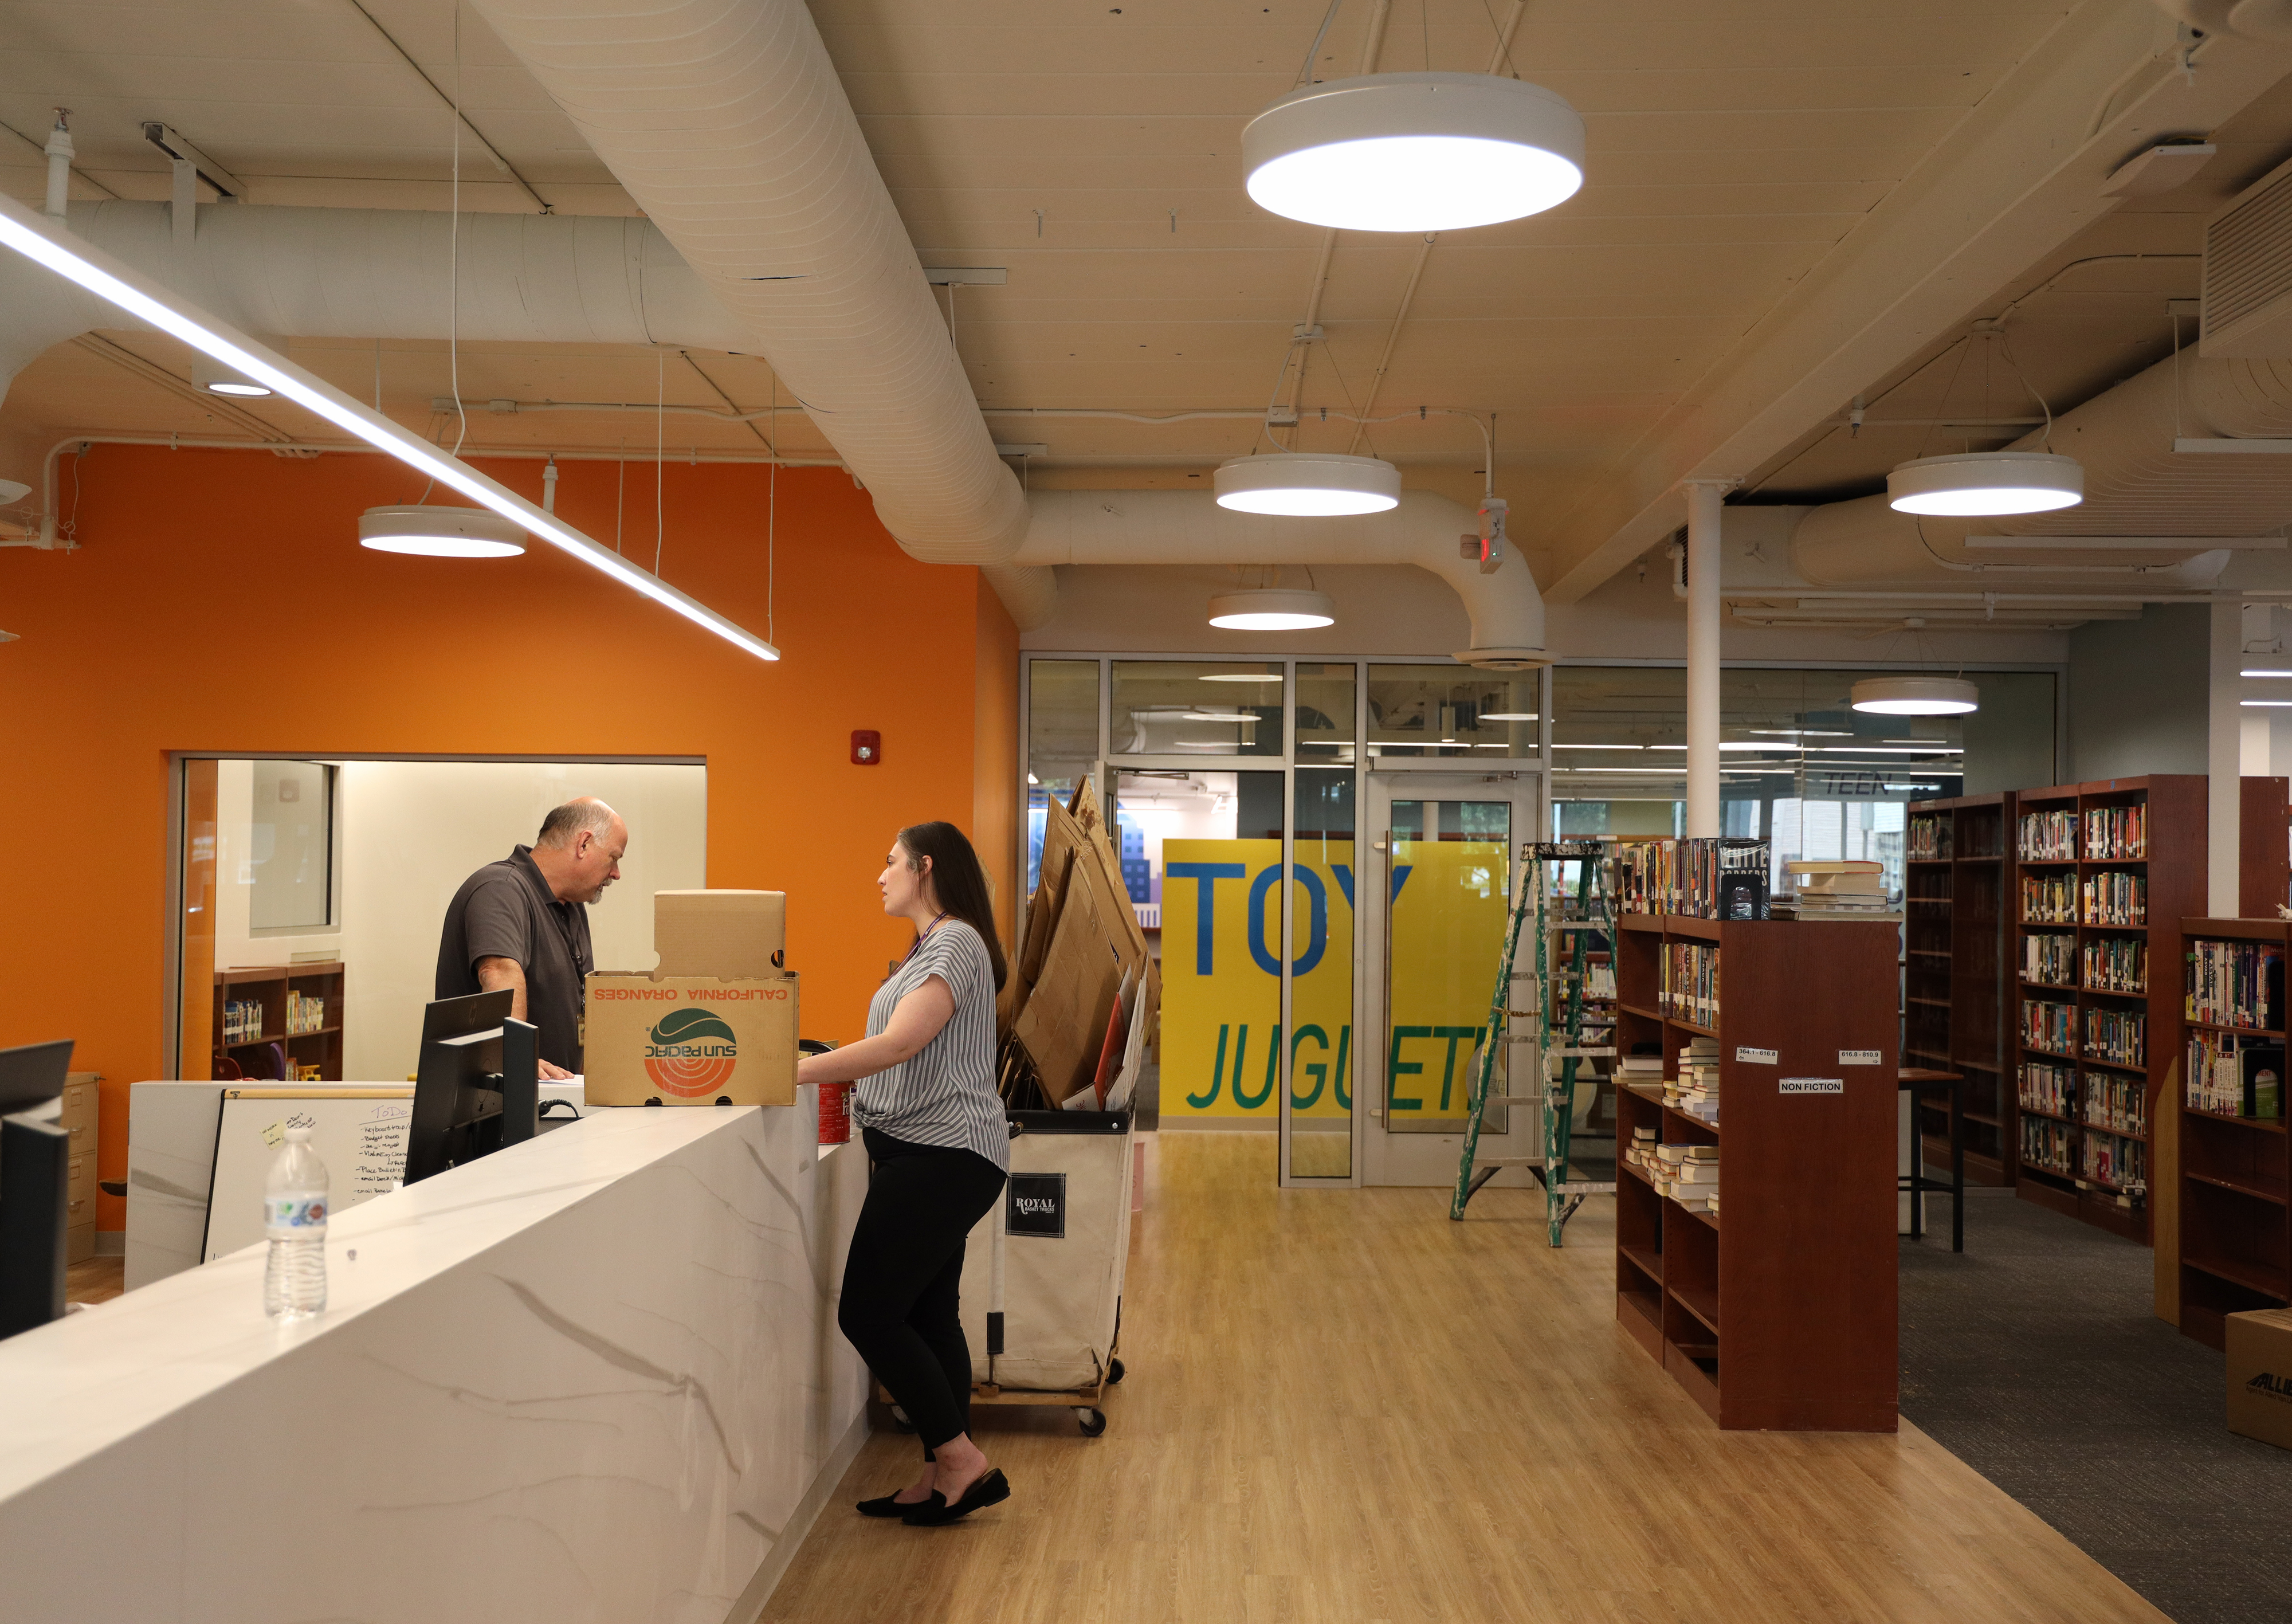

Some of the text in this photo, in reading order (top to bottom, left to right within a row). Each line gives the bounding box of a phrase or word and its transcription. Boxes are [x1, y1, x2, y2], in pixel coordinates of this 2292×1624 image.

[1824, 772, 1892, 795] TEEN
[1720, 846, 1768, 868] WHITE
[594, 989, 788, 1001] CALIFORNIA ORANGES
[704, 1045, 737, 1057] SUN
[1186, 1024, 1506, 1111] JUGET
[1016, 1198, 1055, 1215] ROYAL
[2247, 1372, 2292, 1397] ALLIE
[2265, 1391, 2277, 1399] Allied
[2277, 1394, 2286, 1403] Van
